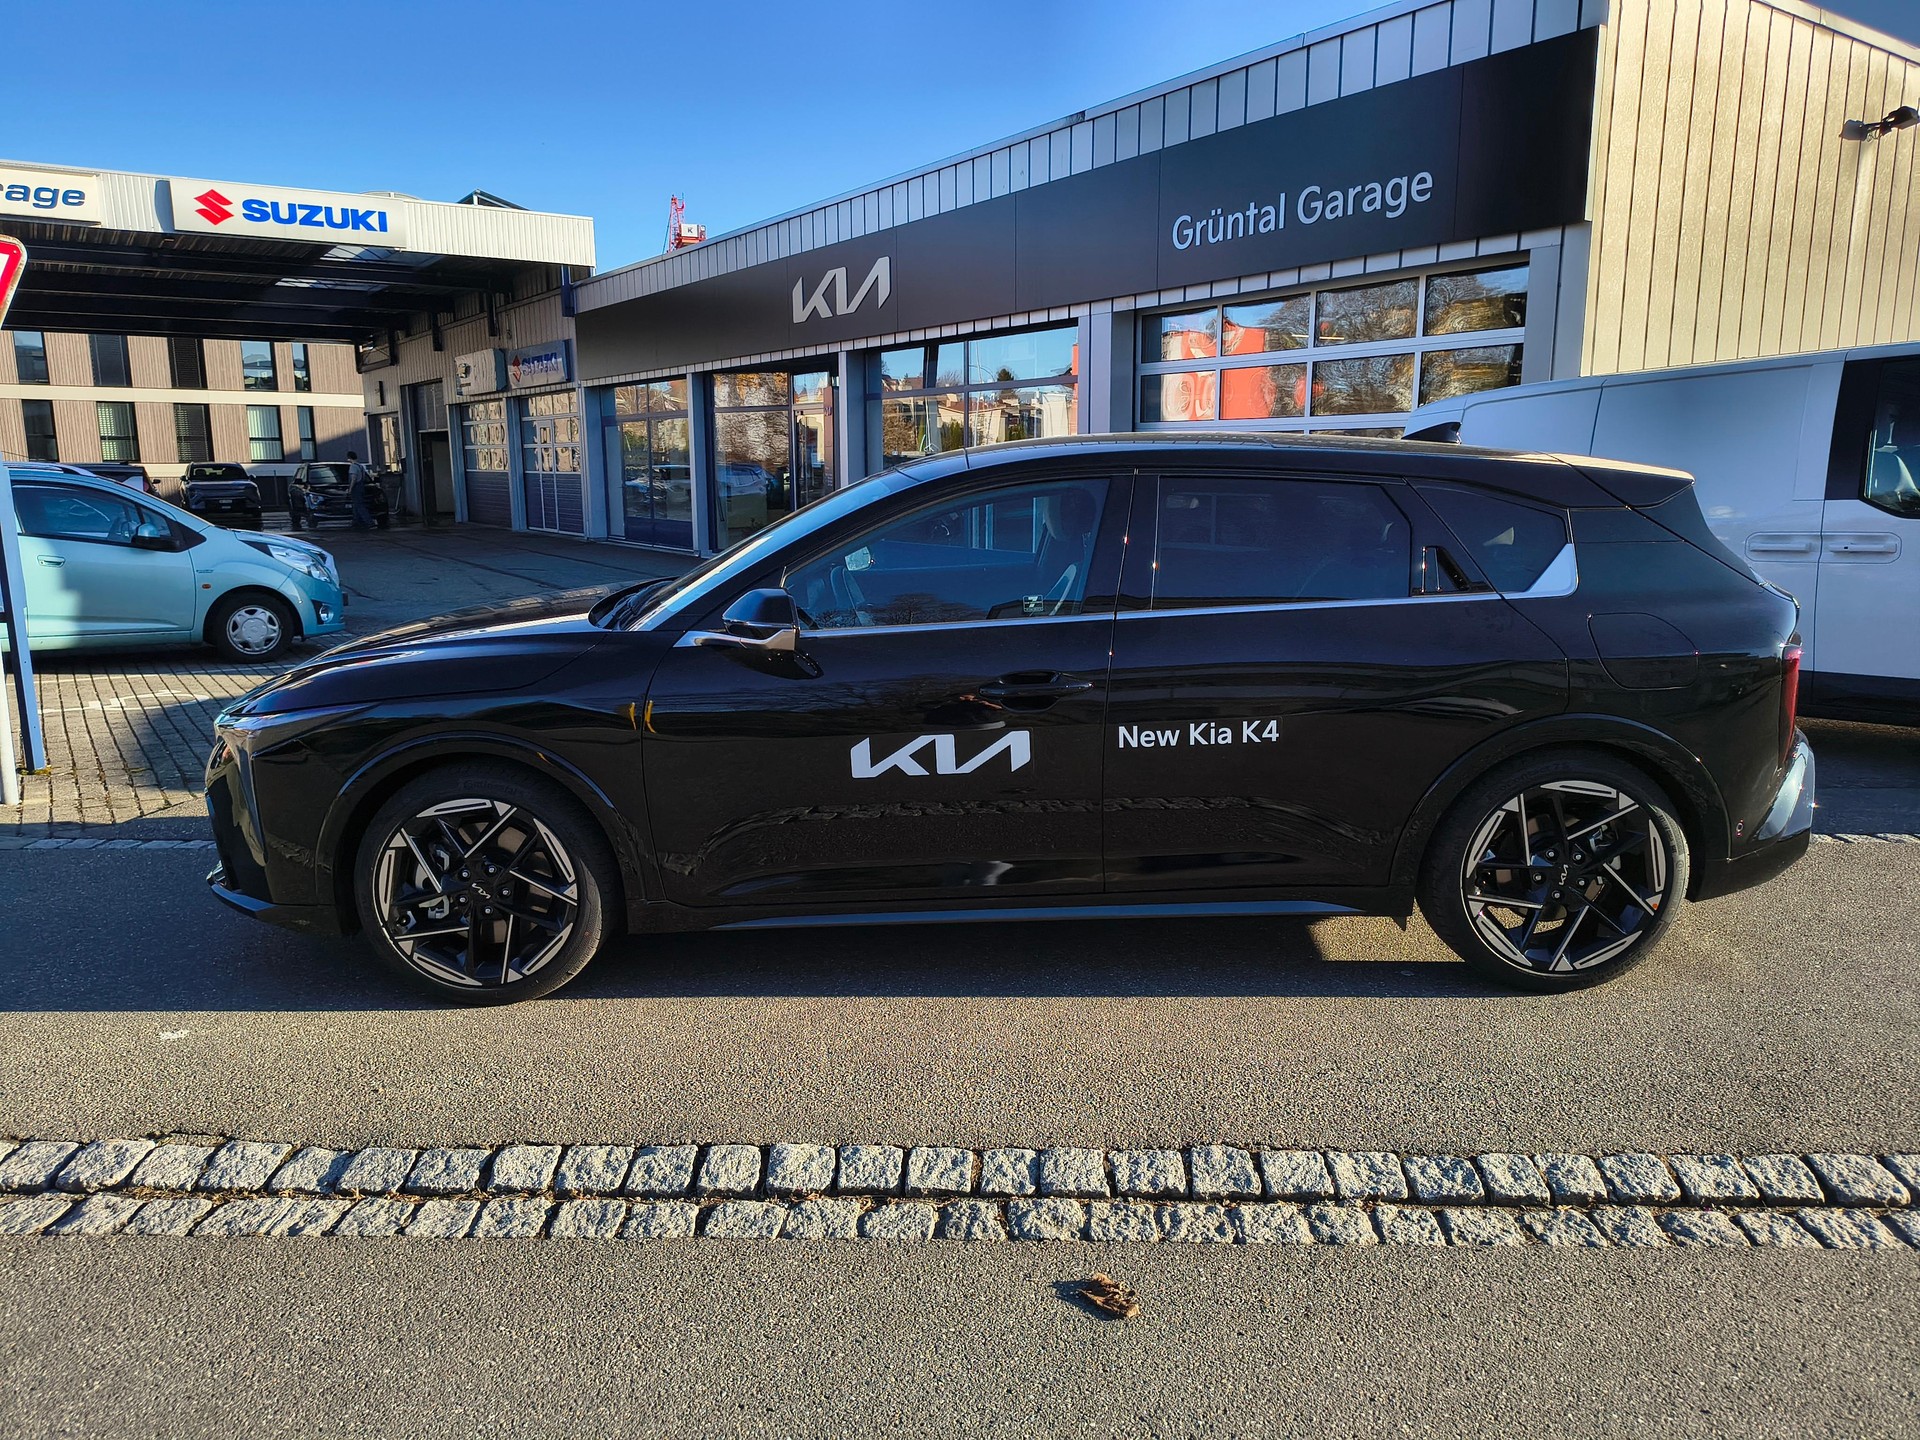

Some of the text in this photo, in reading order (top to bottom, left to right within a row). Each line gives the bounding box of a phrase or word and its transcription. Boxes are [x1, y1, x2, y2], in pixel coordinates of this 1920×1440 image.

[0, 183, 86, 209] age
[242, 198, 389, 233] SUZUKI
[1171, 171, 1433, 250] Grüntal Garage
[792, 256, 890, 324] KIA
[850, 730, 1032, 779] KIA
[1118, 719, 1280, 748] New Kia K4
